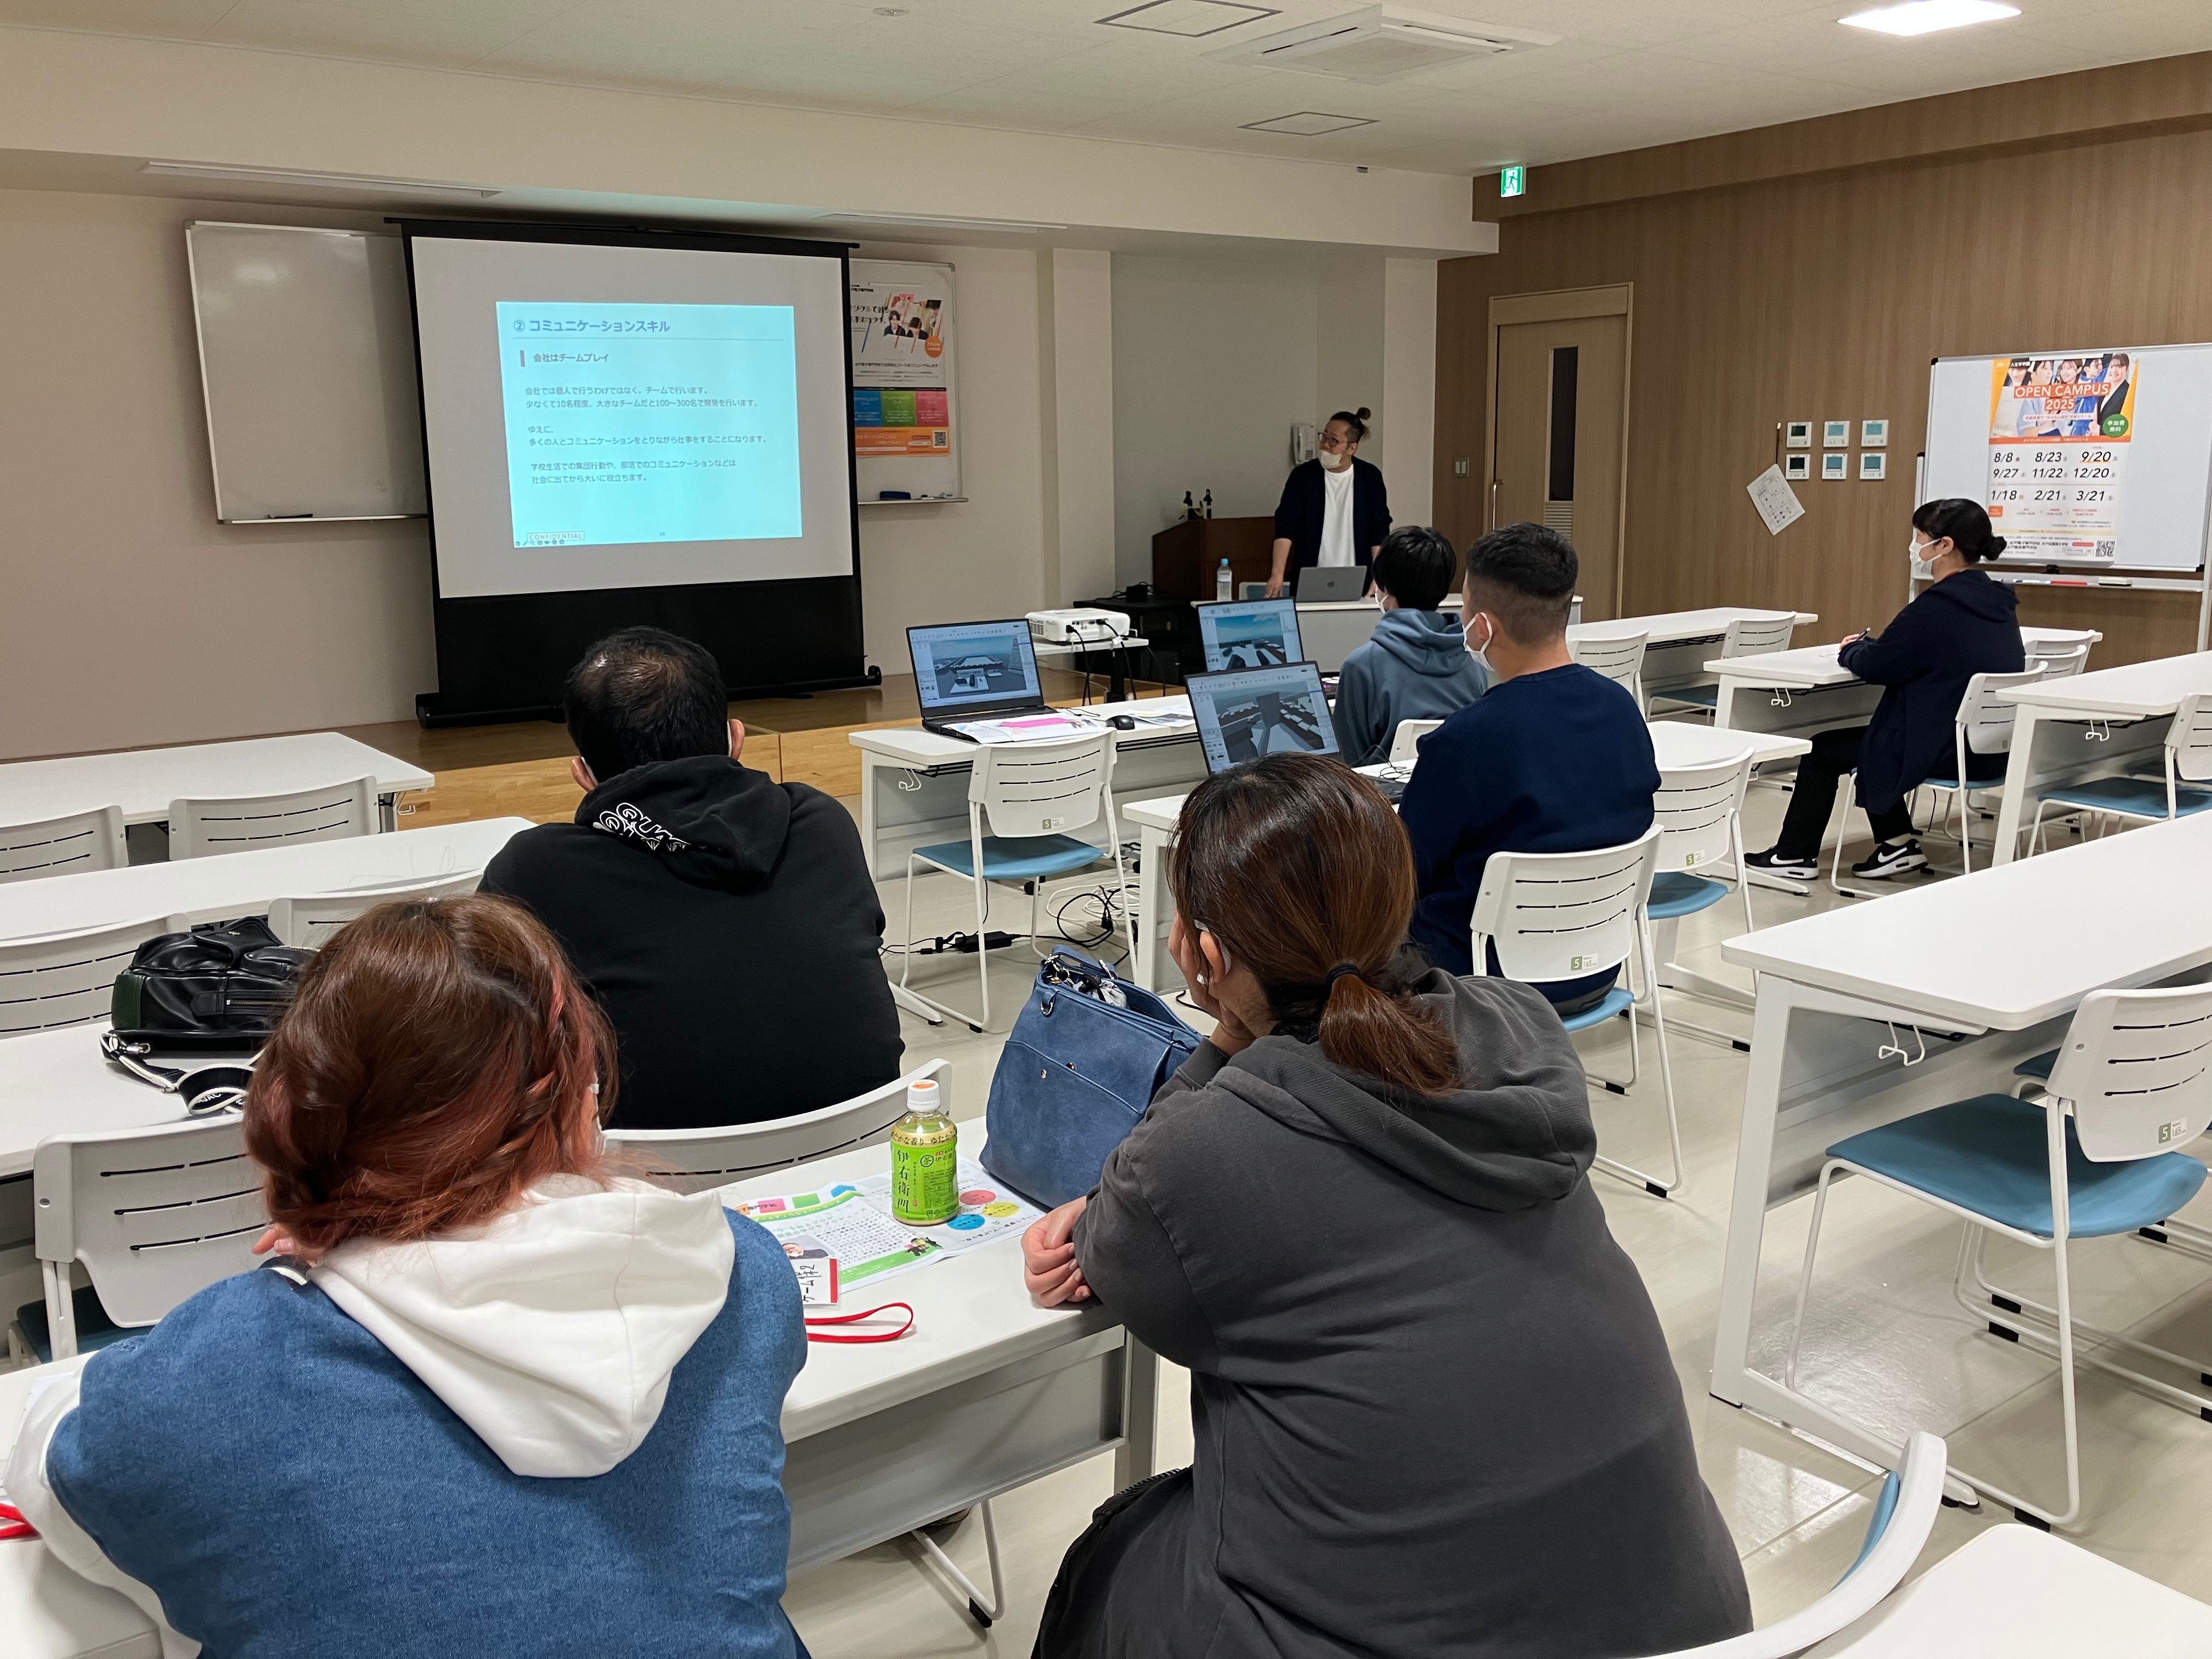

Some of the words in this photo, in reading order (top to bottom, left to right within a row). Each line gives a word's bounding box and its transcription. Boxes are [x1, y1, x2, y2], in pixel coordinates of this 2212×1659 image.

[513, 319, 525, 332] ②
[529, 319, 670, 332] コミュニケーションスキル
[533, 353, 609, 363] 会社はチームプレイ
[2015, 386, 2051, 397] OPEN
[2055, 383, 2109, 396] CAMPUS
[2046, 398, 2074, 410] 2025
[1994, 452, 2013, 463] 8/8
[2035, 452, 2062, 462] 8/23
[2081, 451, 2111, 462] 9/20
[1993, 469, 2019, 478] 9/27
[2033, 468, 2063, 478] 11/22
[2074, 468, 2109, 478] 12/20
[532, 474, 647, 484] 社会に出てから大いに役立ちます。
[1991, 490, 2017, 500] 1/18
[2034, 490, 2061, 500] 2/21
[2076, 490, 2105, 501] 3/21
[1688, 855, 1692, 864] 5
[1575, 958, 1579, 968] 5
[2162, 1126, 2168, 1140] 5
[896, 1149, 910, 1214] 伊右衛門
